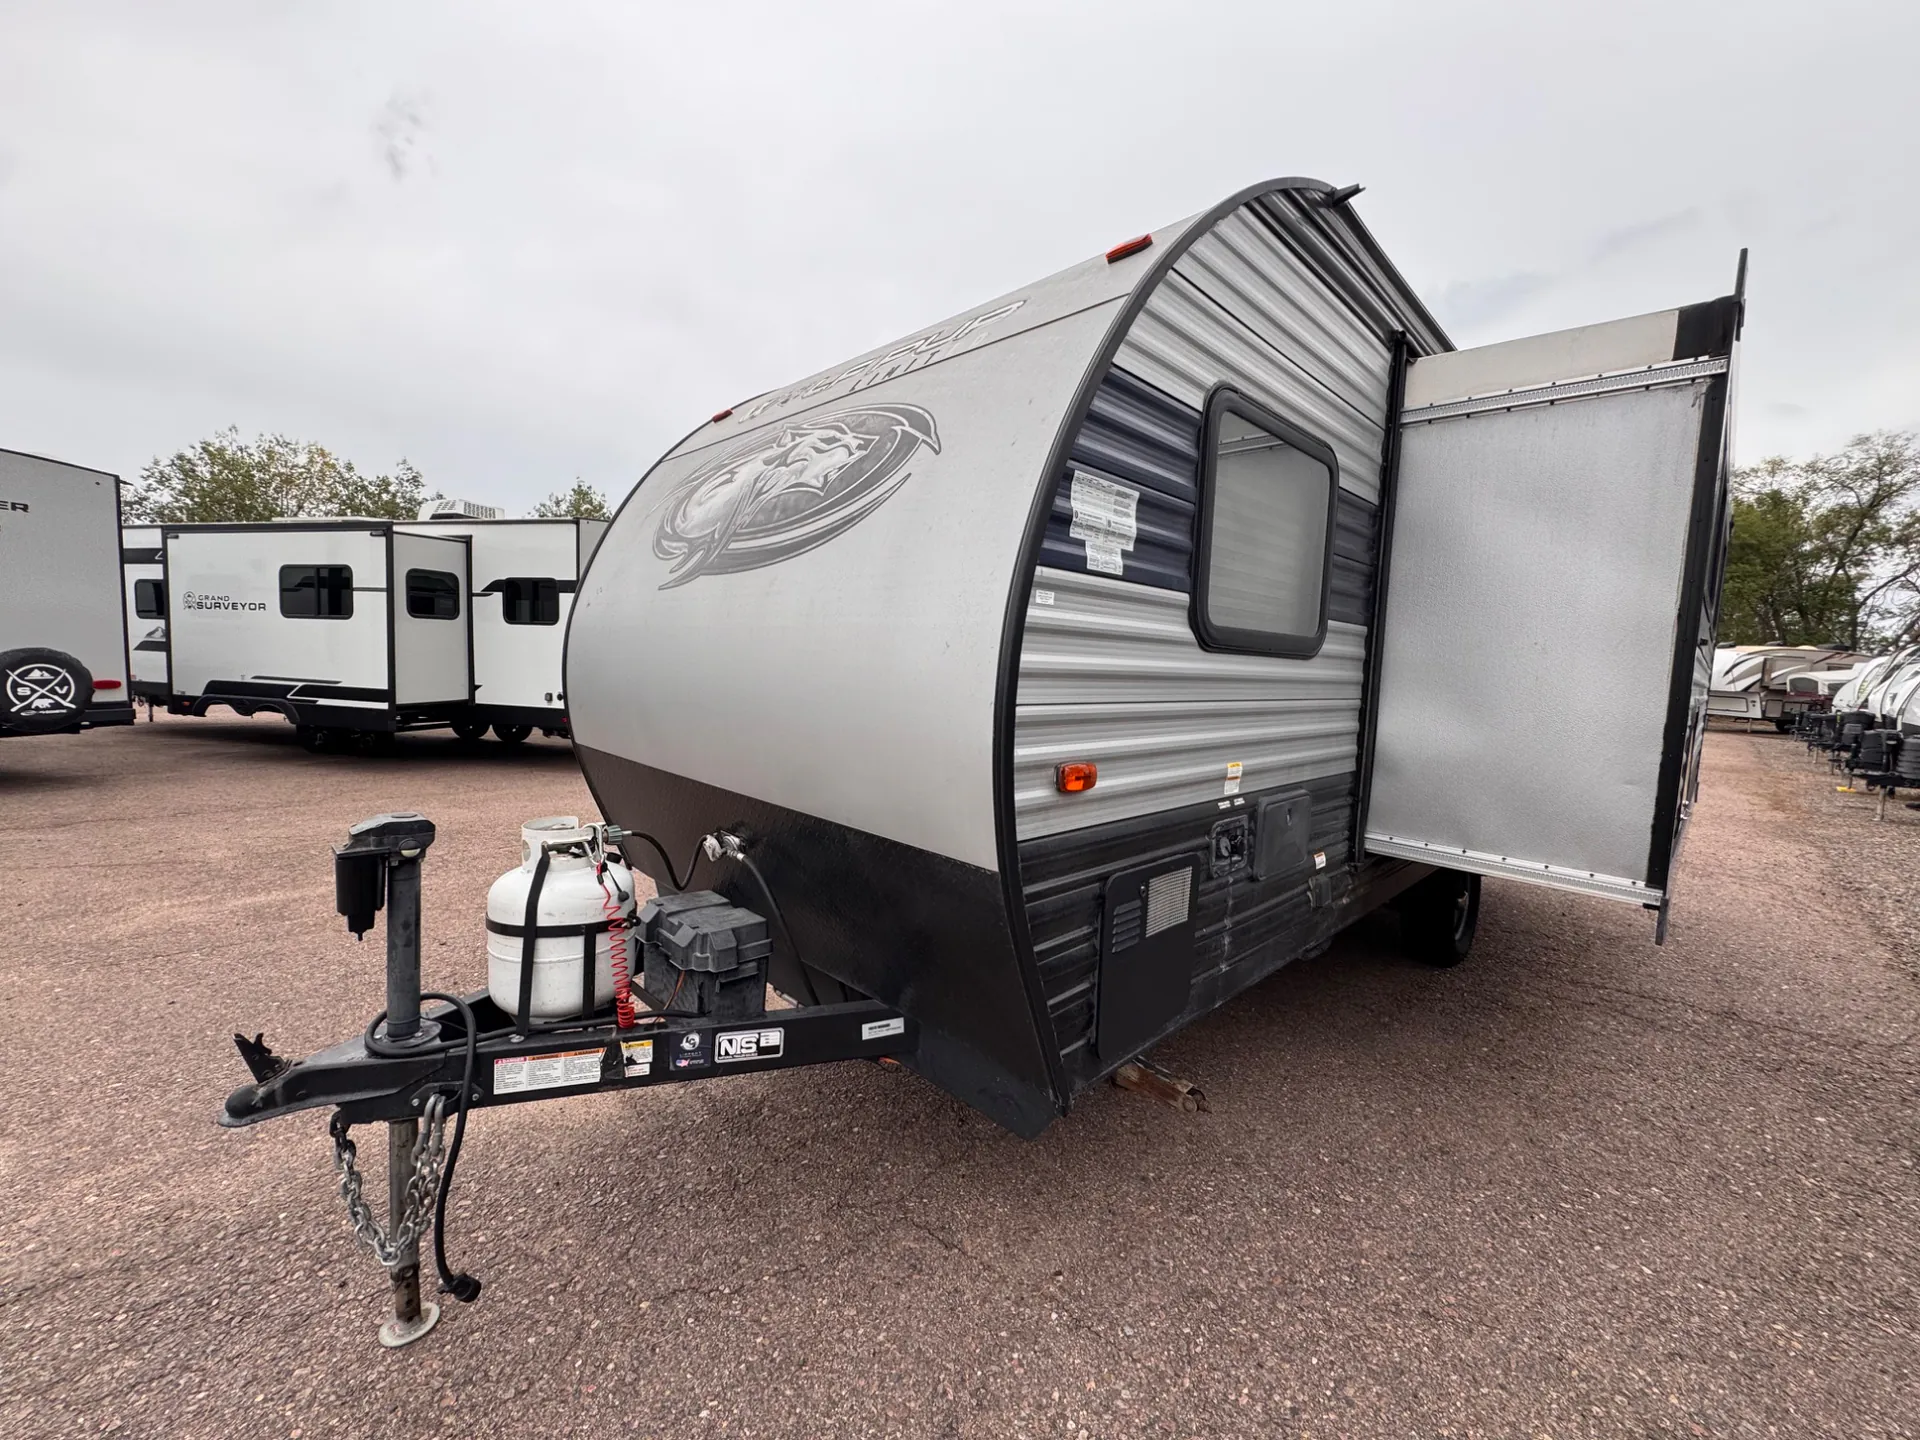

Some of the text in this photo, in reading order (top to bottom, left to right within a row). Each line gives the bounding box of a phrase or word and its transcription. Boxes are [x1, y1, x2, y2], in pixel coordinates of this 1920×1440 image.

[198, 594, 230, 602] GRAND
[196, 601, 267, 611] SURVEYOR
[16, 685, 69, 696] S V
